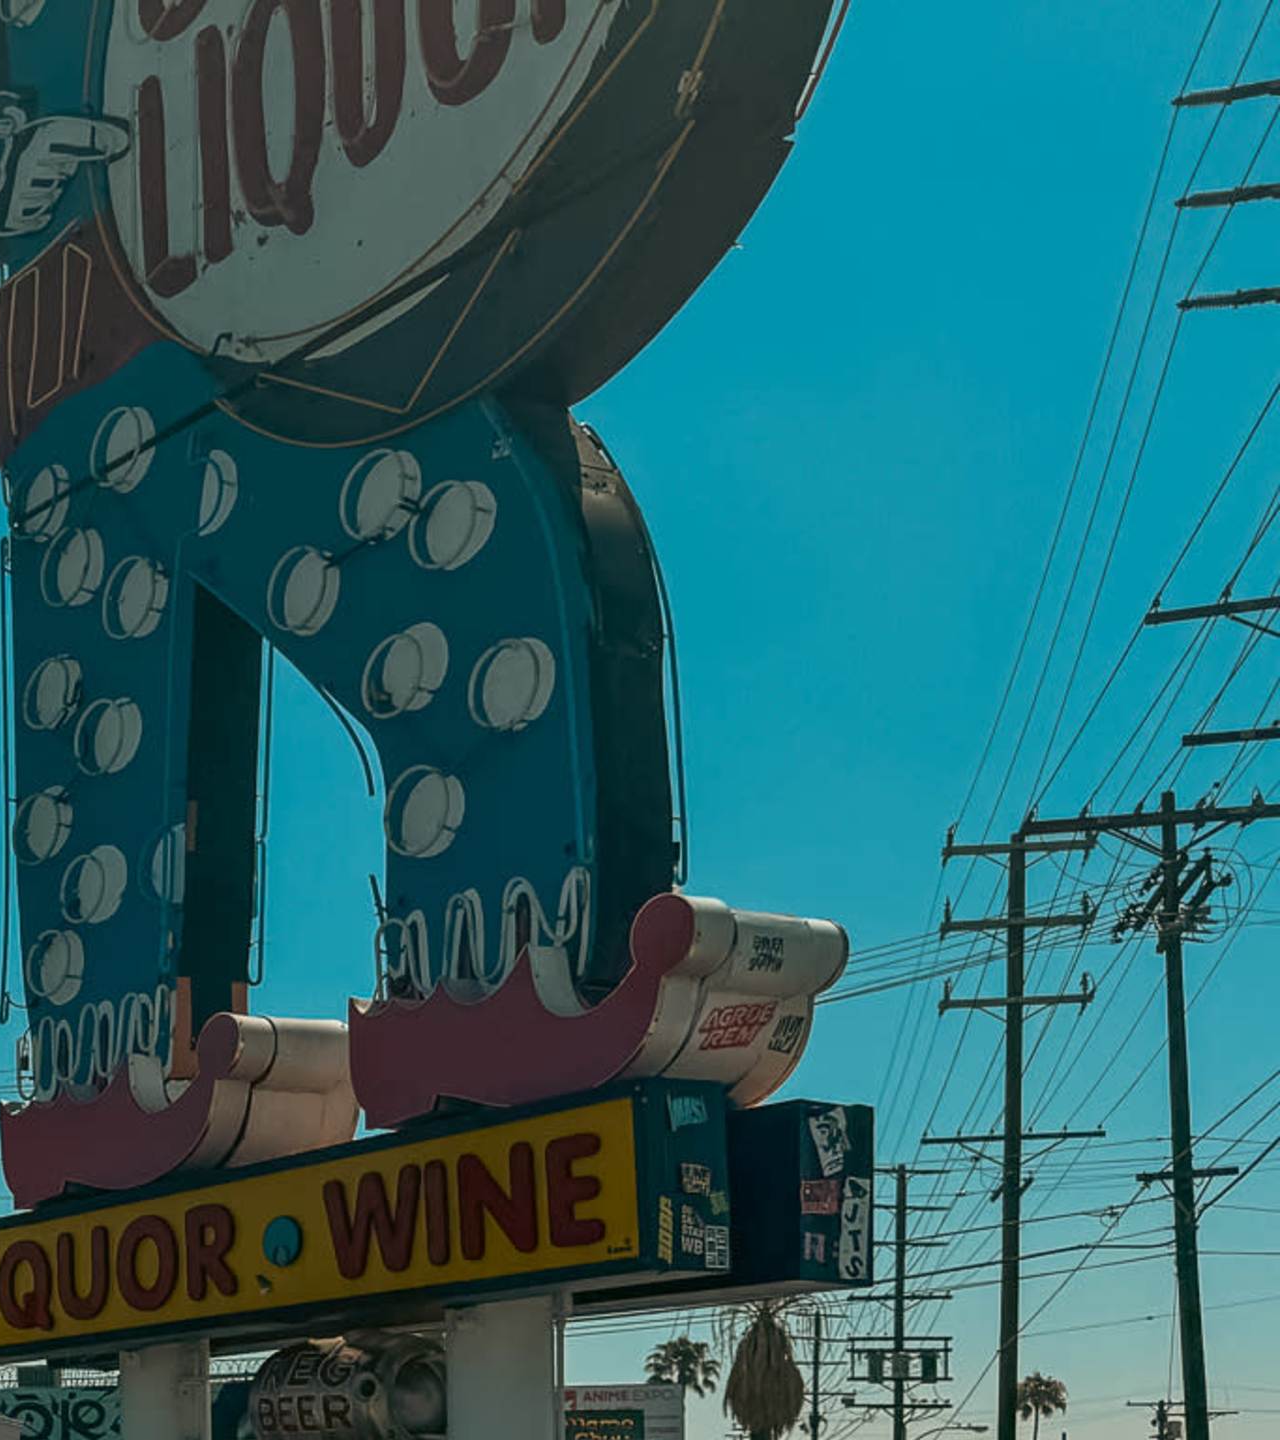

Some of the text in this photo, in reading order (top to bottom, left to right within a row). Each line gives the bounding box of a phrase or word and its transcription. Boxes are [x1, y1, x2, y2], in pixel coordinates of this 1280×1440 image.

[138, 0, 567, 298] LIQU
[321, 1133, 605, 1280] WINE
[258, 1394, 353, 1432] BEER
[583, 1389, 627, 1403] ANIME
